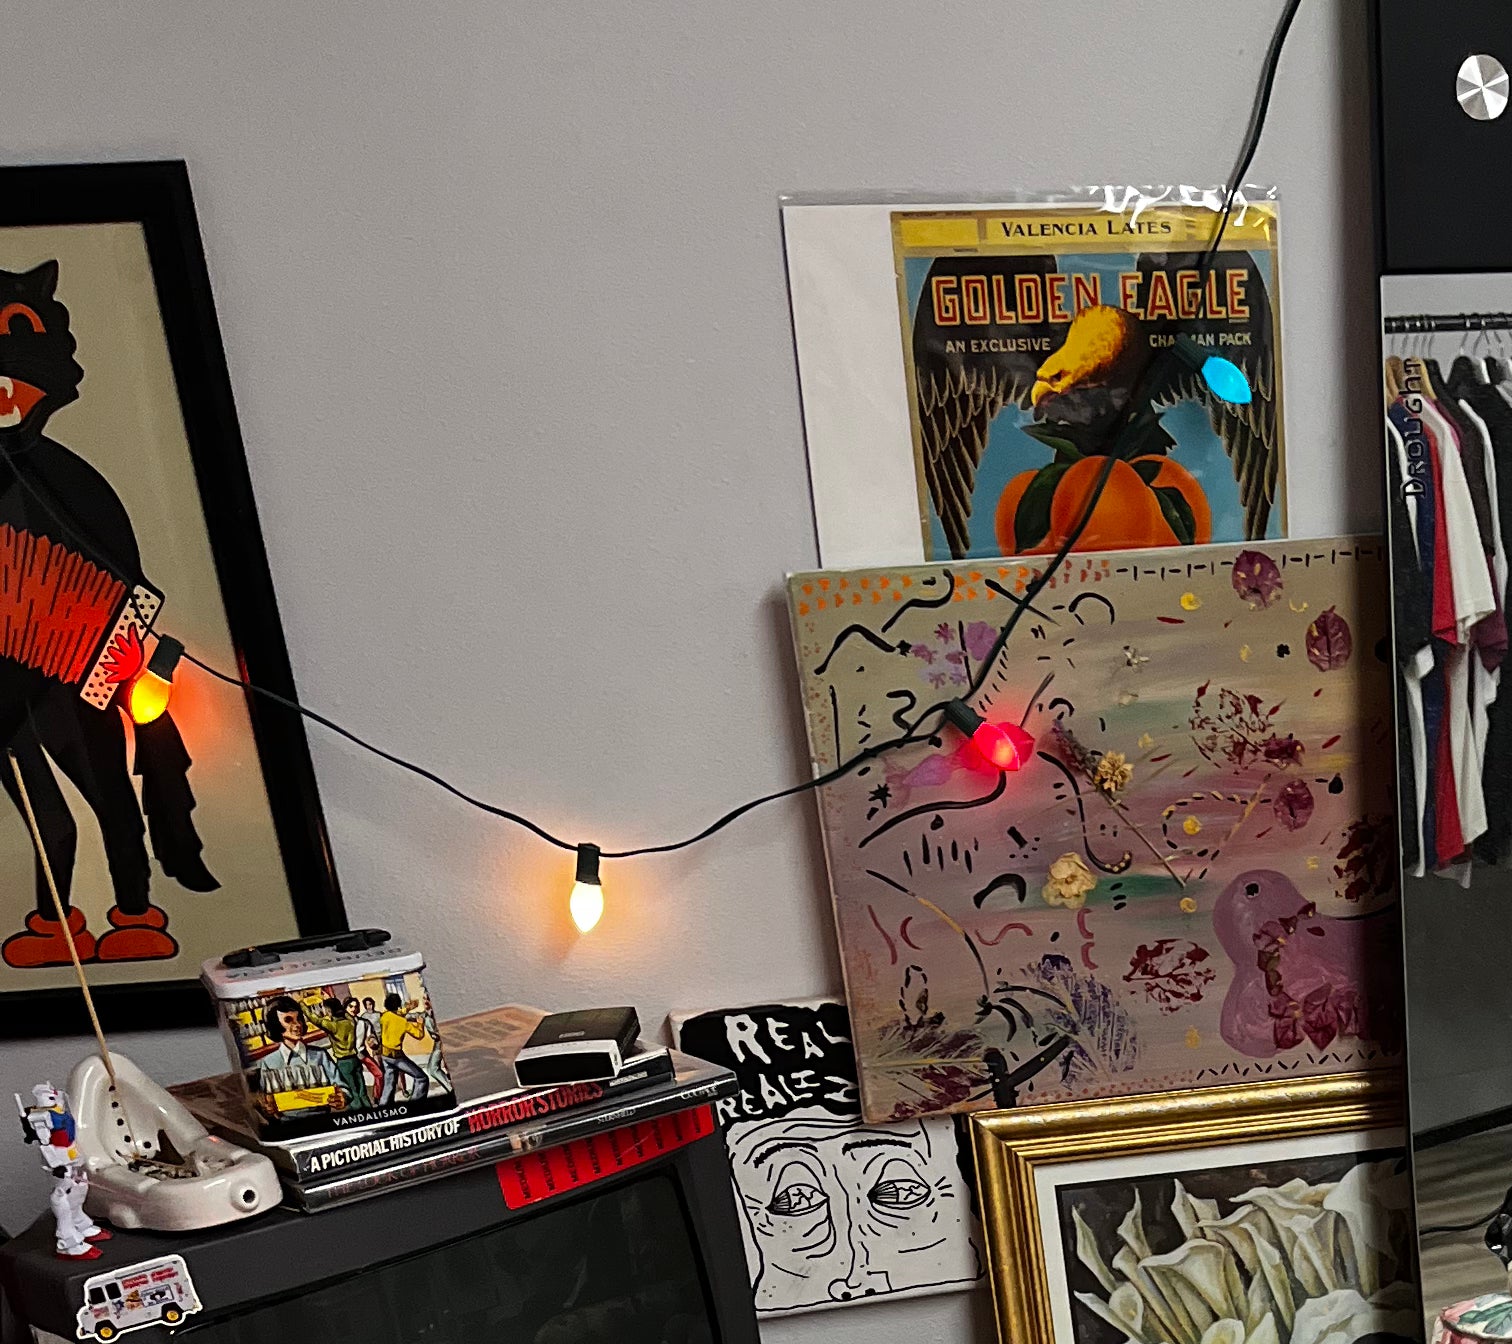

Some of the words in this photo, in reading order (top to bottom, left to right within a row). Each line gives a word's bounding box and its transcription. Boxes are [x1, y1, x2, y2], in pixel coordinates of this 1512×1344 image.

[1001, 221, 1098, 237] VALENCIA
[1107, 220, 1172, 235] LATES
[931, 272, 1100, 327] GOLDEN
[1119, 268, 1251, 321] EAGLE
[945, 340, 965, 354] AN
[969, 337, 1051, 353] EXCLUSIVE
[1149, 333, 1214, 348] CHAAN
[1218, 331, 1252, 346] PACK
[724, 1013, 852, 1064] REAL
[310, 1156, 321, 1174] A
[322, 1138, 390, 1170] PICTORIAL
[389, 1120, 442, 1151] HISTORY
[445, 1117, 463, 1136] OF
[466, 1097, 537, 1134] HORROR
[333, 1106, 408, 1128] VANDALISMO
